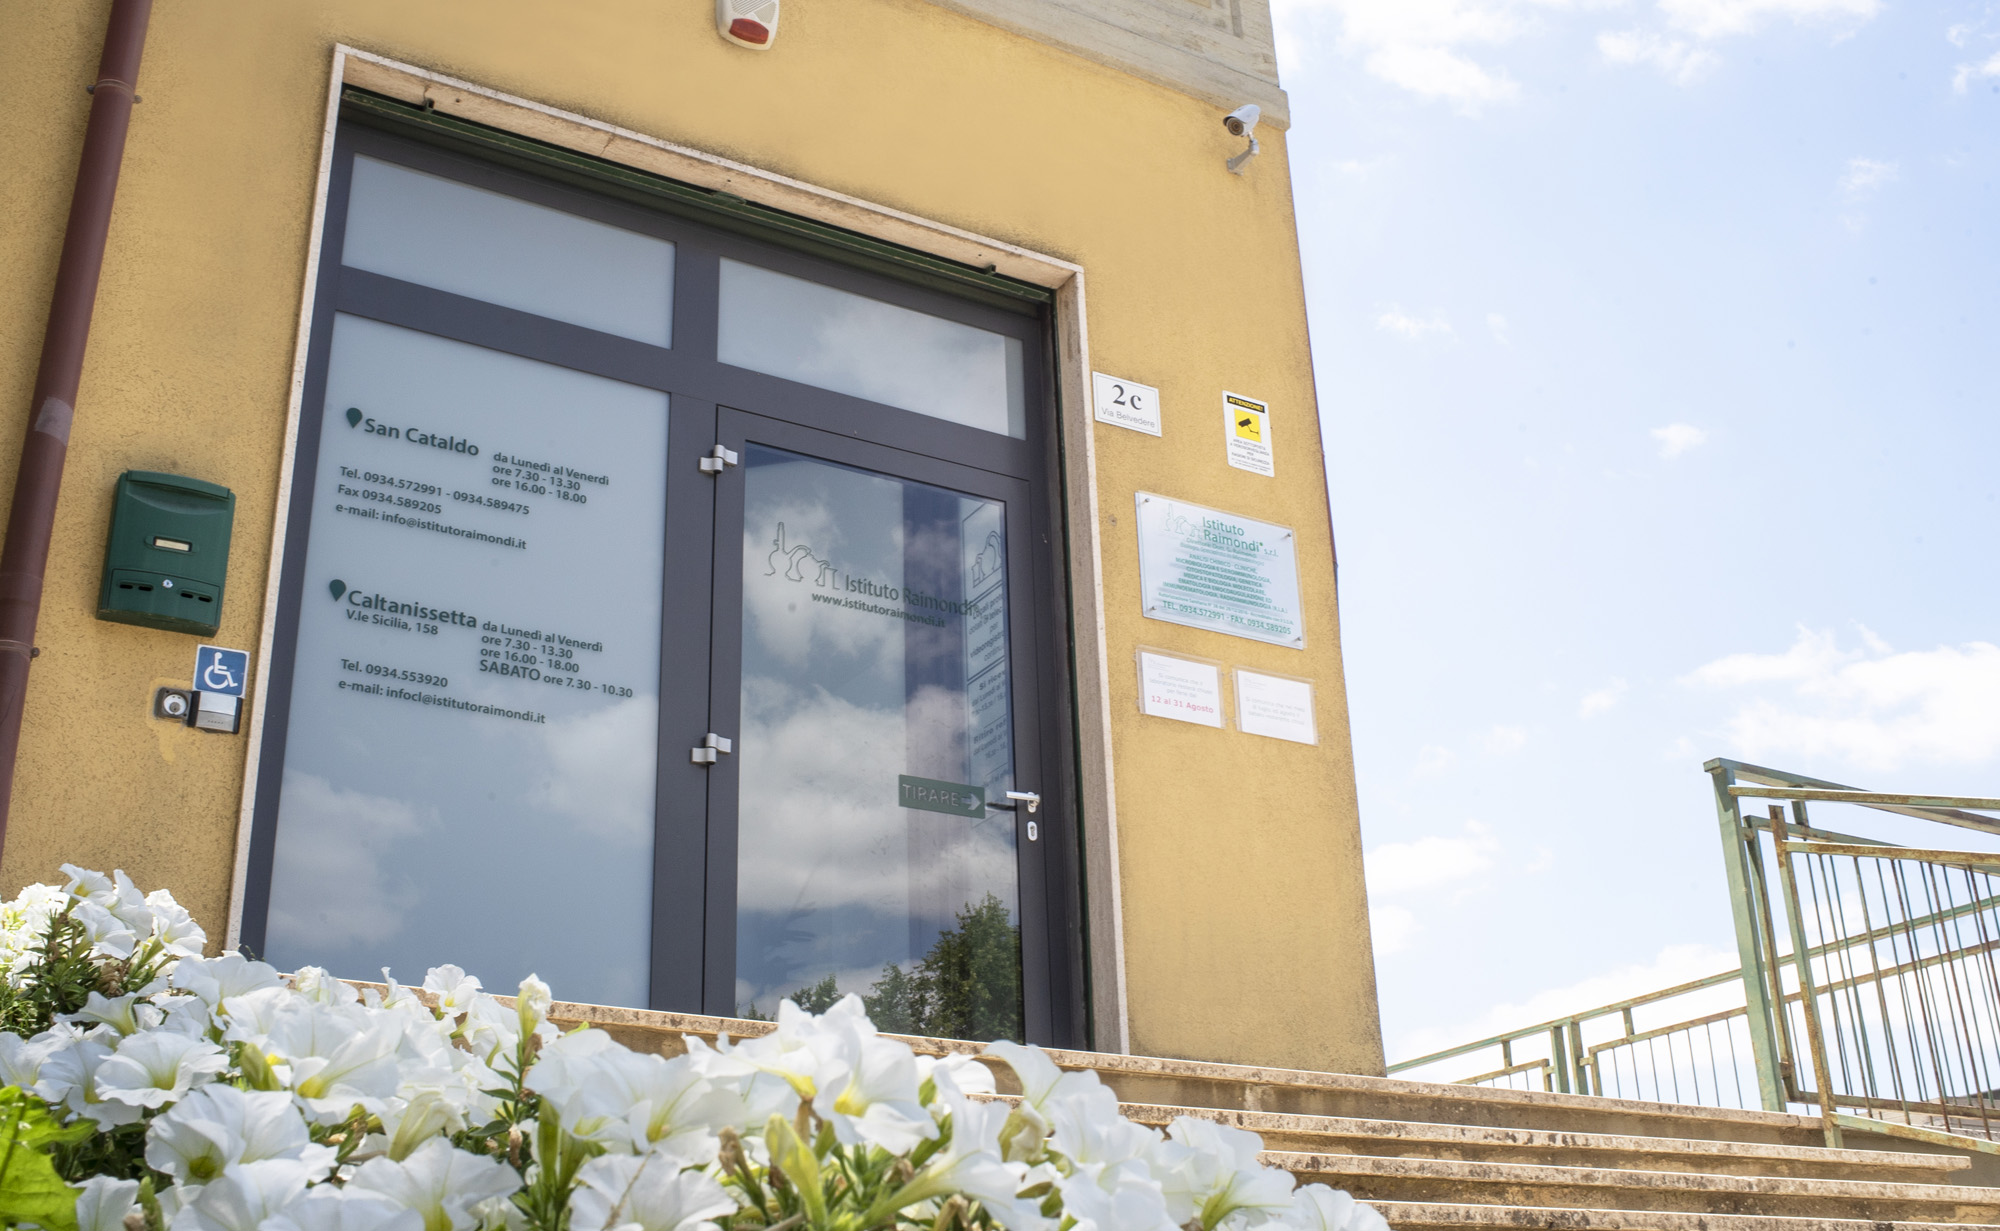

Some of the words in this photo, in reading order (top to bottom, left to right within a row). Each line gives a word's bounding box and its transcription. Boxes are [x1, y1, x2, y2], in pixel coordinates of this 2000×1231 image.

[1102, 408, 1114, 417] Via
[1116, 411, 1155, 428] Belvedere
[364, 418, 400, 439] San
[406, 428, 479, 456] Cataldo
[493, 452, 508, 463] da
[511, 456, 551, 473] Lunedì
[553, 466, 563, 476] al
[566, 468, 609, 486] Venerdì
[493, 466, 512, 476] ore
[515, 469, 539, 482] 7.30
[550, 476, 580, 491] 13.30
[338, 484, 359, 498] Fax
[362, 490, 442, 514] 0934.589205
[340, 466, 361, 480] Tel.
[364, 472, 442, 497] 0934.572991
[453, 491, 530, 515] 0934.589475
[491, 477, 511, 488] ore
[515, 481, 546, 495] 16.00
[556, 490, 587, 504] 18.00
[335, 504, 379, 520] e-mail:
[382, 512, 527, 550] info@istitutoraimondi.it
[1202, 516, 1244, 536] Istituto
[845, 574, 899, 600] Istituto
[346, 609, 369, 623] V.le
[372, 614, 412, 632] Sicilia,
[416, 622, 438, 635] 158
[348, 591, 477, 628] Caltanissetta
[812, 593, 946, 628] www.istitutoraimondi.it
[1162, 600, 1177, 610] TEL.
[1179, 603, 1224, 620] 0934.572991
[1230, 614, 1245, 625] FAX.
[1247, 618, 1291, 635] 0934.589205
[481, 635, 501, 646] ore
[505, 638, 530, 651] 7.30
[541, 645, 572, 659] 13.30
[483, 621, 497, 632] da
[501, 625, 542, 641] Lunedì
[545, 633, 555, 644] al
[557, 635, 602, 652] Venerdì
[341, 659, 362, 673] Tel.
[365, 664, 448, 688] 0934.553920
[480, 648, 501, 659] ore
[504, 651, 536, 665] 16.00
[548, 659, 579, 673] 18.00
[479, 660, 541, 681] SABATO
[543, 675, 563, 686] ore
[602, 684, 633, 698] 10.30
[338, 680, 383, 696] e-mail:
[386, 687, 546, 723] infocl@istitutoraimondi.it
[1152, 695, 1161, 704] 12
[1174, 699, 1183, 708] 31
[1186, 702, 1214, 714] Agosto
[902, 784, 959, 807] TIRARE
